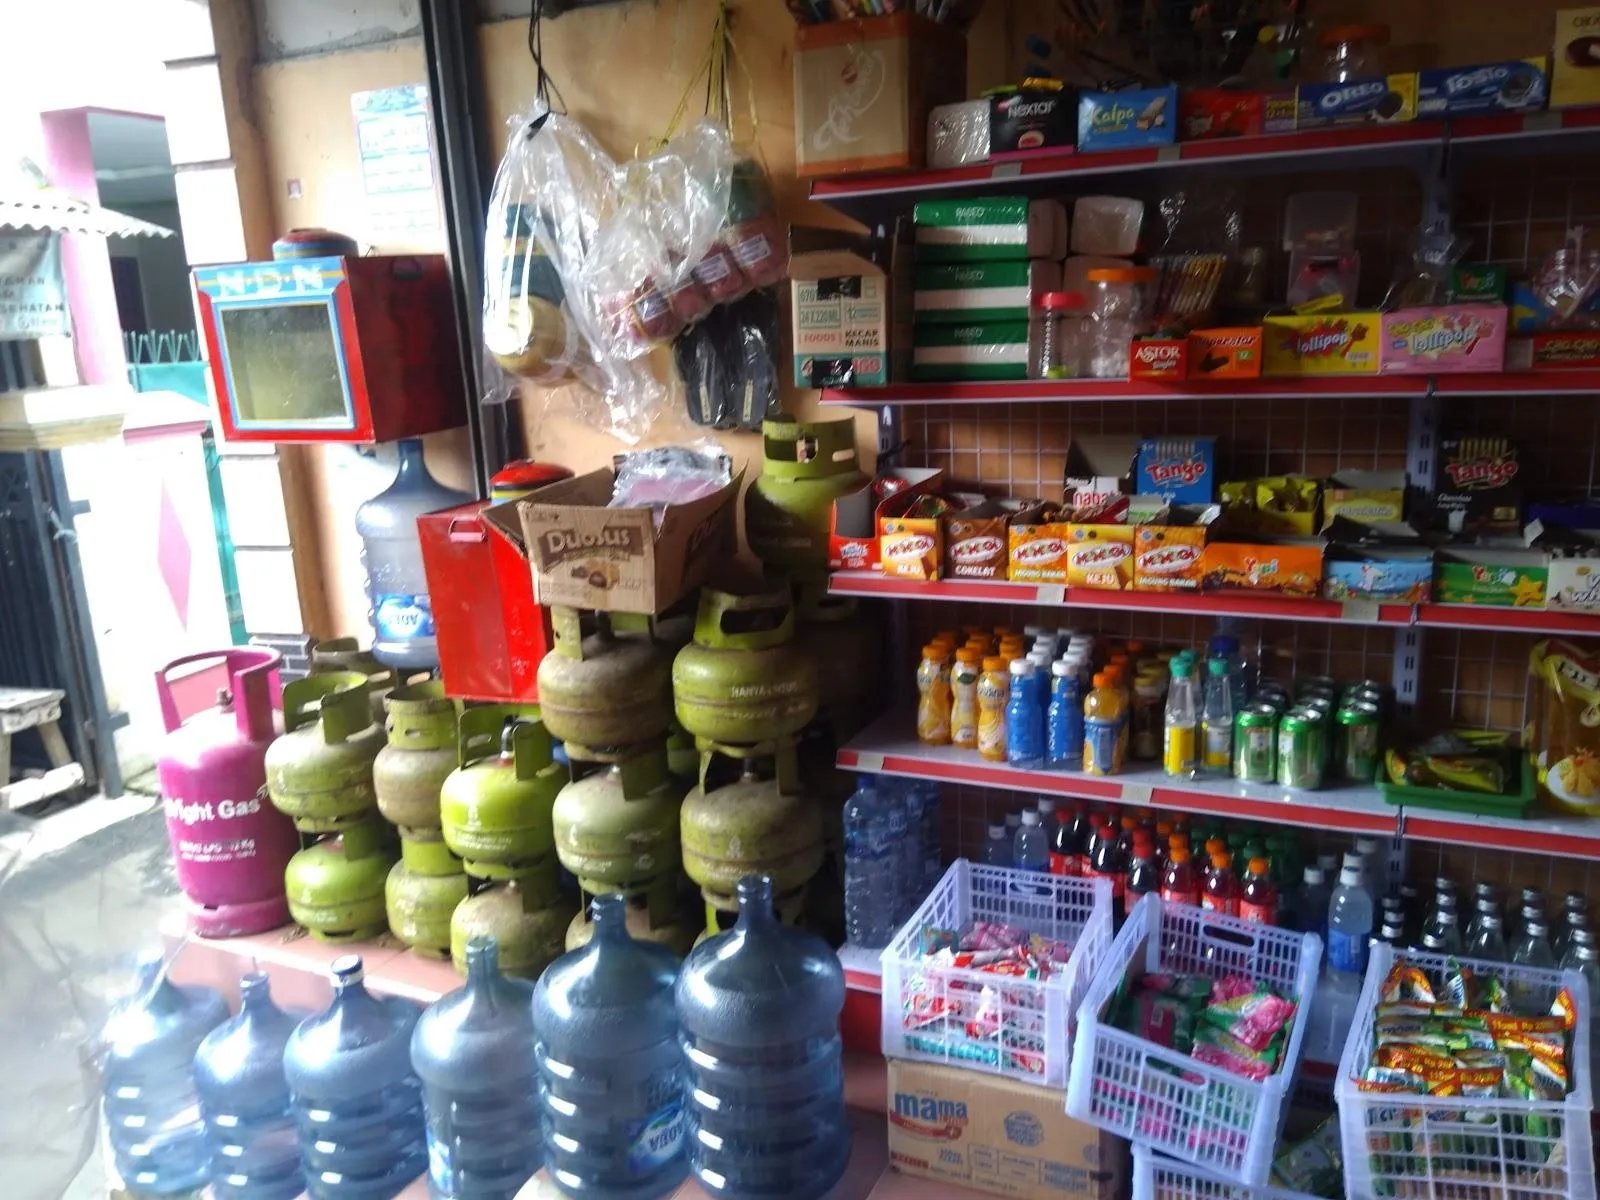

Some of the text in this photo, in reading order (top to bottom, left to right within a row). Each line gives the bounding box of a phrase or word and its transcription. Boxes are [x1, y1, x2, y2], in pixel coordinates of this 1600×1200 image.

[1320, 81, 1385, 111] OREO
[845, 329, 879, 339] KECAP
[845, 339, 880, 347] MANIS
[1135, 346, 1181, 363] ASTOR
[1146, 462, 1206, 485] Tango
[1444, 460, 1519, 487] Tango
[955, 565, 995, 576] COKELAT
[217, 799, 261, 819] Gas
[894, 1092, 968, 1121] mama
